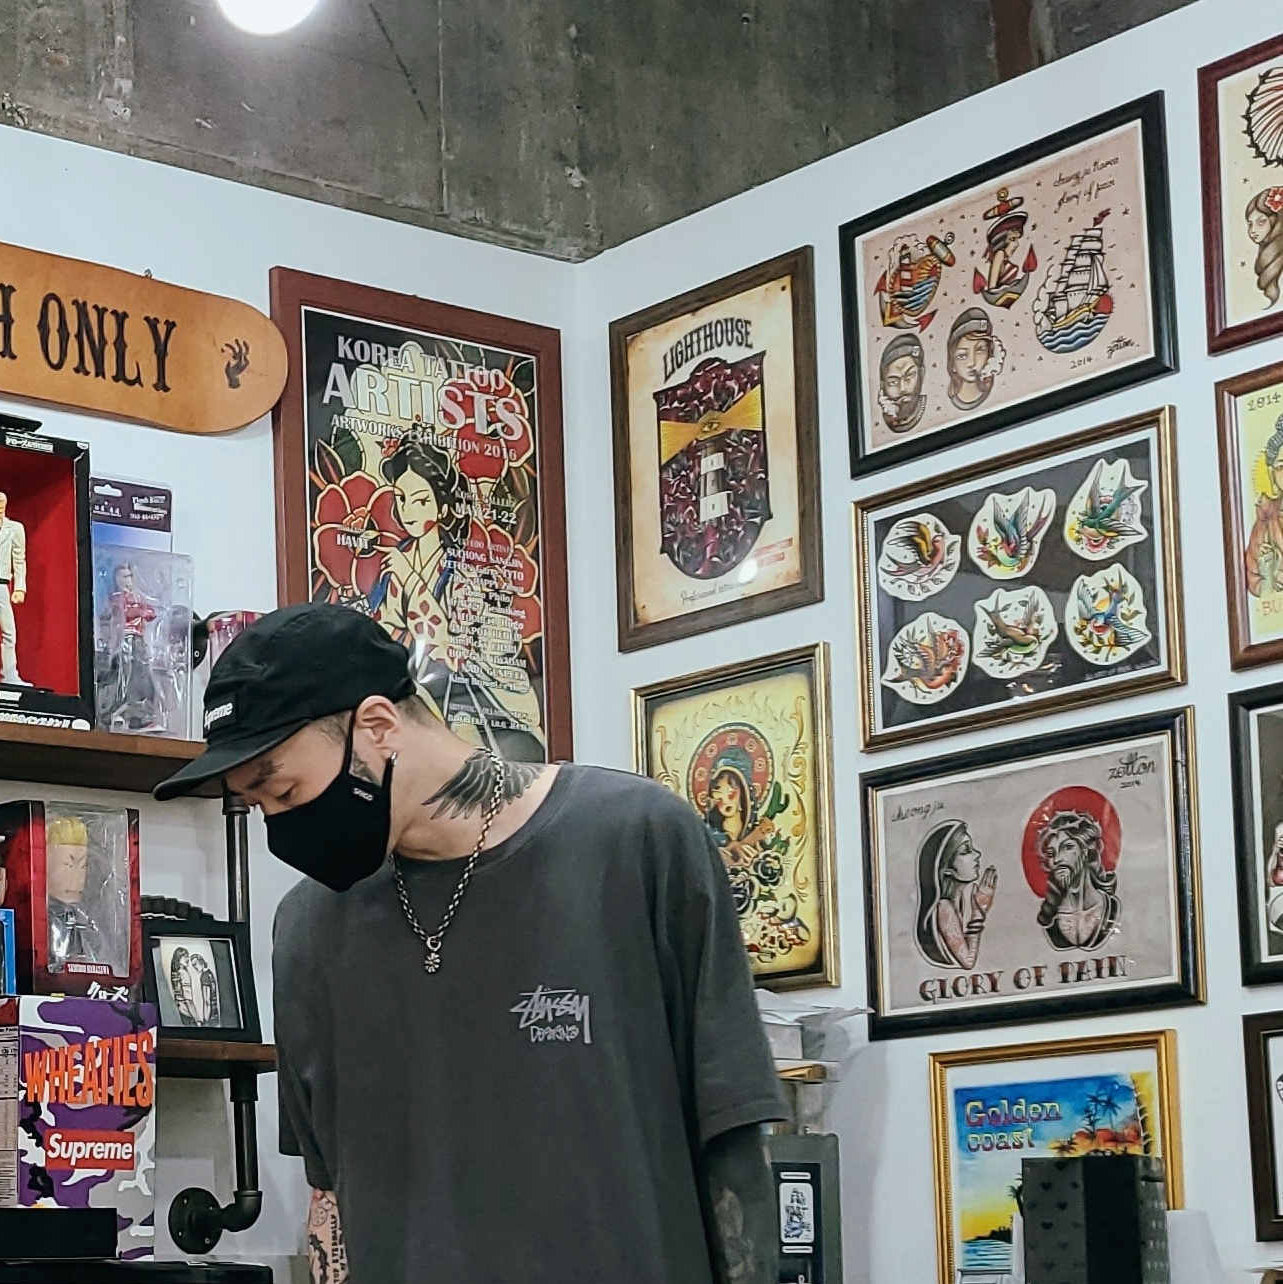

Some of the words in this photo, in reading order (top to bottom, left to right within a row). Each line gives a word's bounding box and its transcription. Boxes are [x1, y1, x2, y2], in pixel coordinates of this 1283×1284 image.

[37, 292, 178, 392] ONLY
[337, 335, 415, 373] KOREA
[420, 352, 505, 391] TATTOO
[662, 317, 754, 384] LIGHTHOUSE
[322, 362, 523, 441] ARTISTS
[331, 413, 404, 440] ARTWORKS
[408, 429, 480, 454] EXHIBITION
[483, 443, 517, 460] 2016
[918, 969, 1004, 1004] GLORY
[1012, 965, 1048, 990] OF
[1058, 954, 1129, 985] PAIN
[24, 1032, 153, 1108] WHEATIES
[964, 1099, 1062, 1128] Golden
[47, 1132, 134, 1161] Supreme
[966, 1127, 1036, 1154] coast
